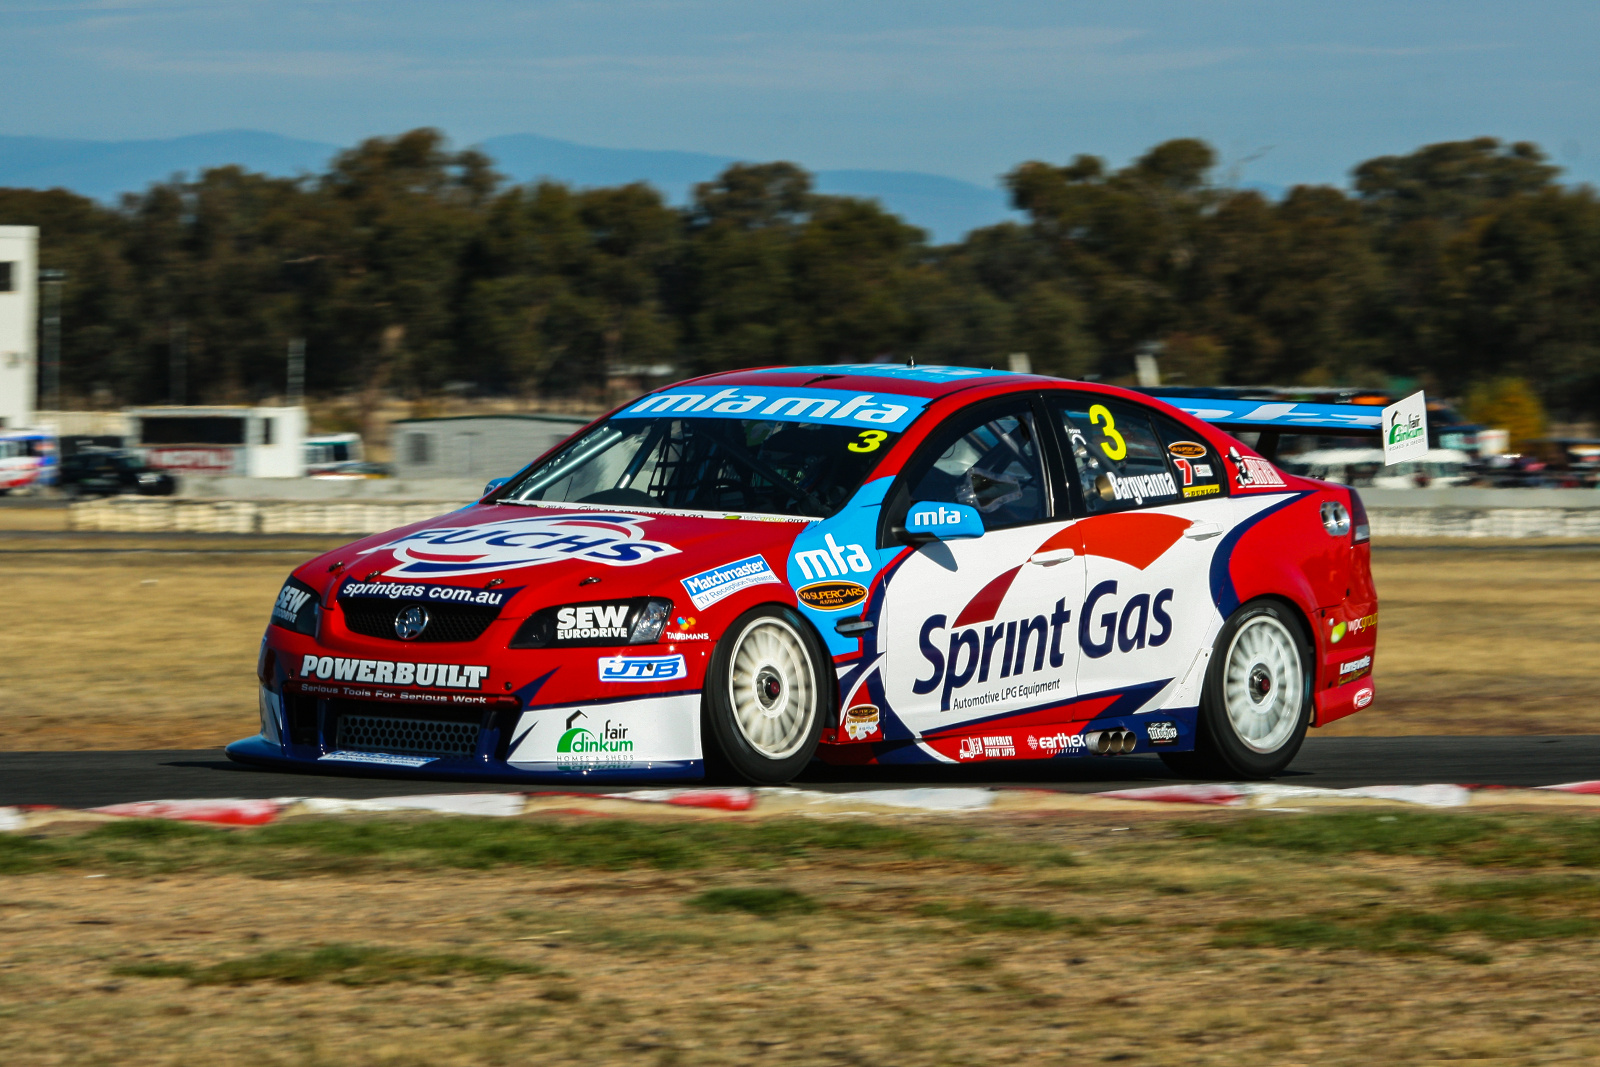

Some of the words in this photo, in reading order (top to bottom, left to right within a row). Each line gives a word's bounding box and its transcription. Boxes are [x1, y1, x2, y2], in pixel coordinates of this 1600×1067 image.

[629, 388, 767, 413] mta
[760, 395, 909, 424] mta
[847, 430, 888, 453] 3
[1089, 404, 1127, 460] 3
[1107, 471, 1178, 505] Bargwanna
[1191, 488, 1219, 496] DUNLOP
[914, 507, 961, 526] mta
[383, 529, 664, 561] FUCHS
[795, 533, 872, 579] mta
[687, 561, 764, 594] Matchmaster
[275, 585, 311, 613] SEW
[428, 588, 503, 605] com.au
[697, 595, 710, 604] TV
[810, 587, 864, 600] SUPERCARS
[556, 606, 630, 629] SEW
[557, 627, 628, 640] EURODRIVE
[912, 596, 1071, 712] Sprint
[1078, 580, 1174, 659] Gas
[301, 655, 489, 688] POWERBUILT
[301, 683, 340, 694] Serious
[342, 687, 372, 697] Tools
[375, 690, 396, 698] For
[400, 692, 448, 702] Serious
[452, 695, 487, 704] Work
[953, 691, 1000, 710] Automotive
[1001, 685, 1017, 700] LPG
[1018, 678, 1061, 698] Equipment
[605, 720, 628, 740] fair
[983, 736, 1013, 746] WAVERLEY
[572, 732, 634, 753] dinkum
[985, 748, 1001, 757] FORK
[1002, 747, 1016, 756] LIFTS
